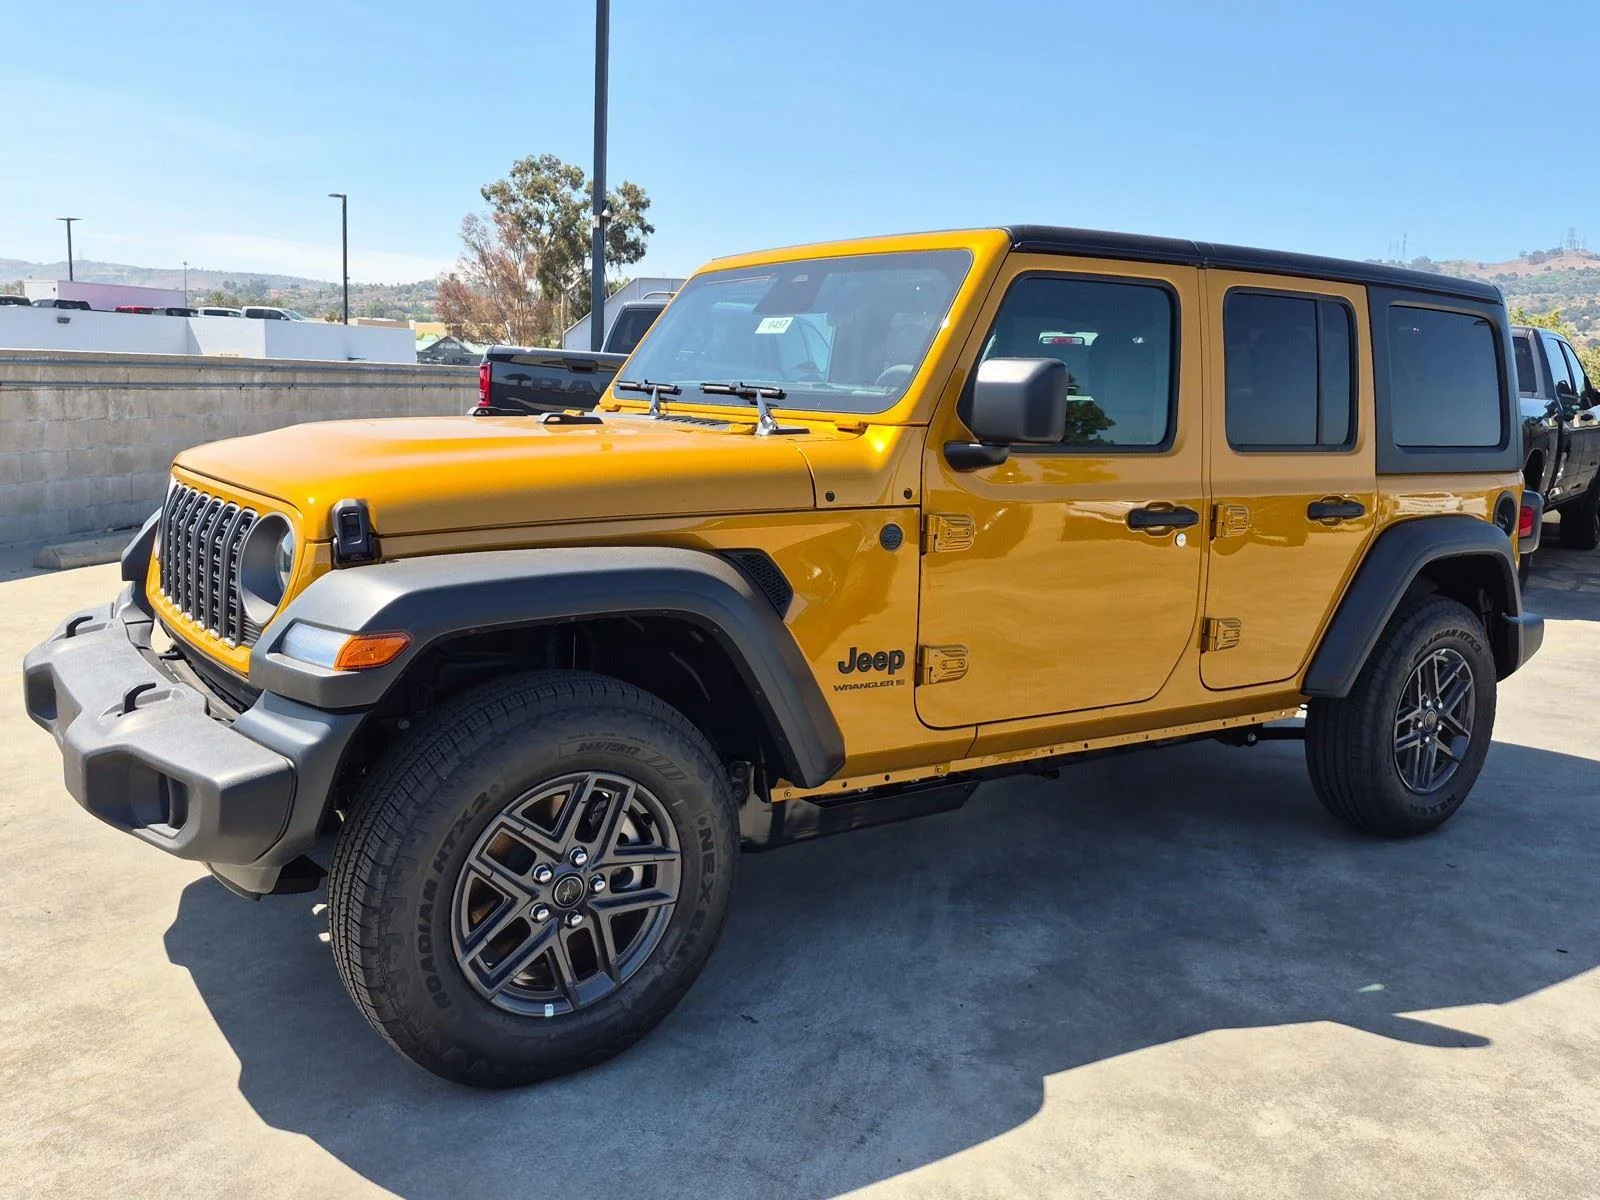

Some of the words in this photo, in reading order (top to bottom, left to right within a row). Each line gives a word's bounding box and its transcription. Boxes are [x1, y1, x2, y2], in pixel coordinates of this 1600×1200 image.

[838, 647, 905, 675] Jeep
[833, 680, 895, 692] WRANGLER
[418, 878, 452, 1010] ROADIAN
